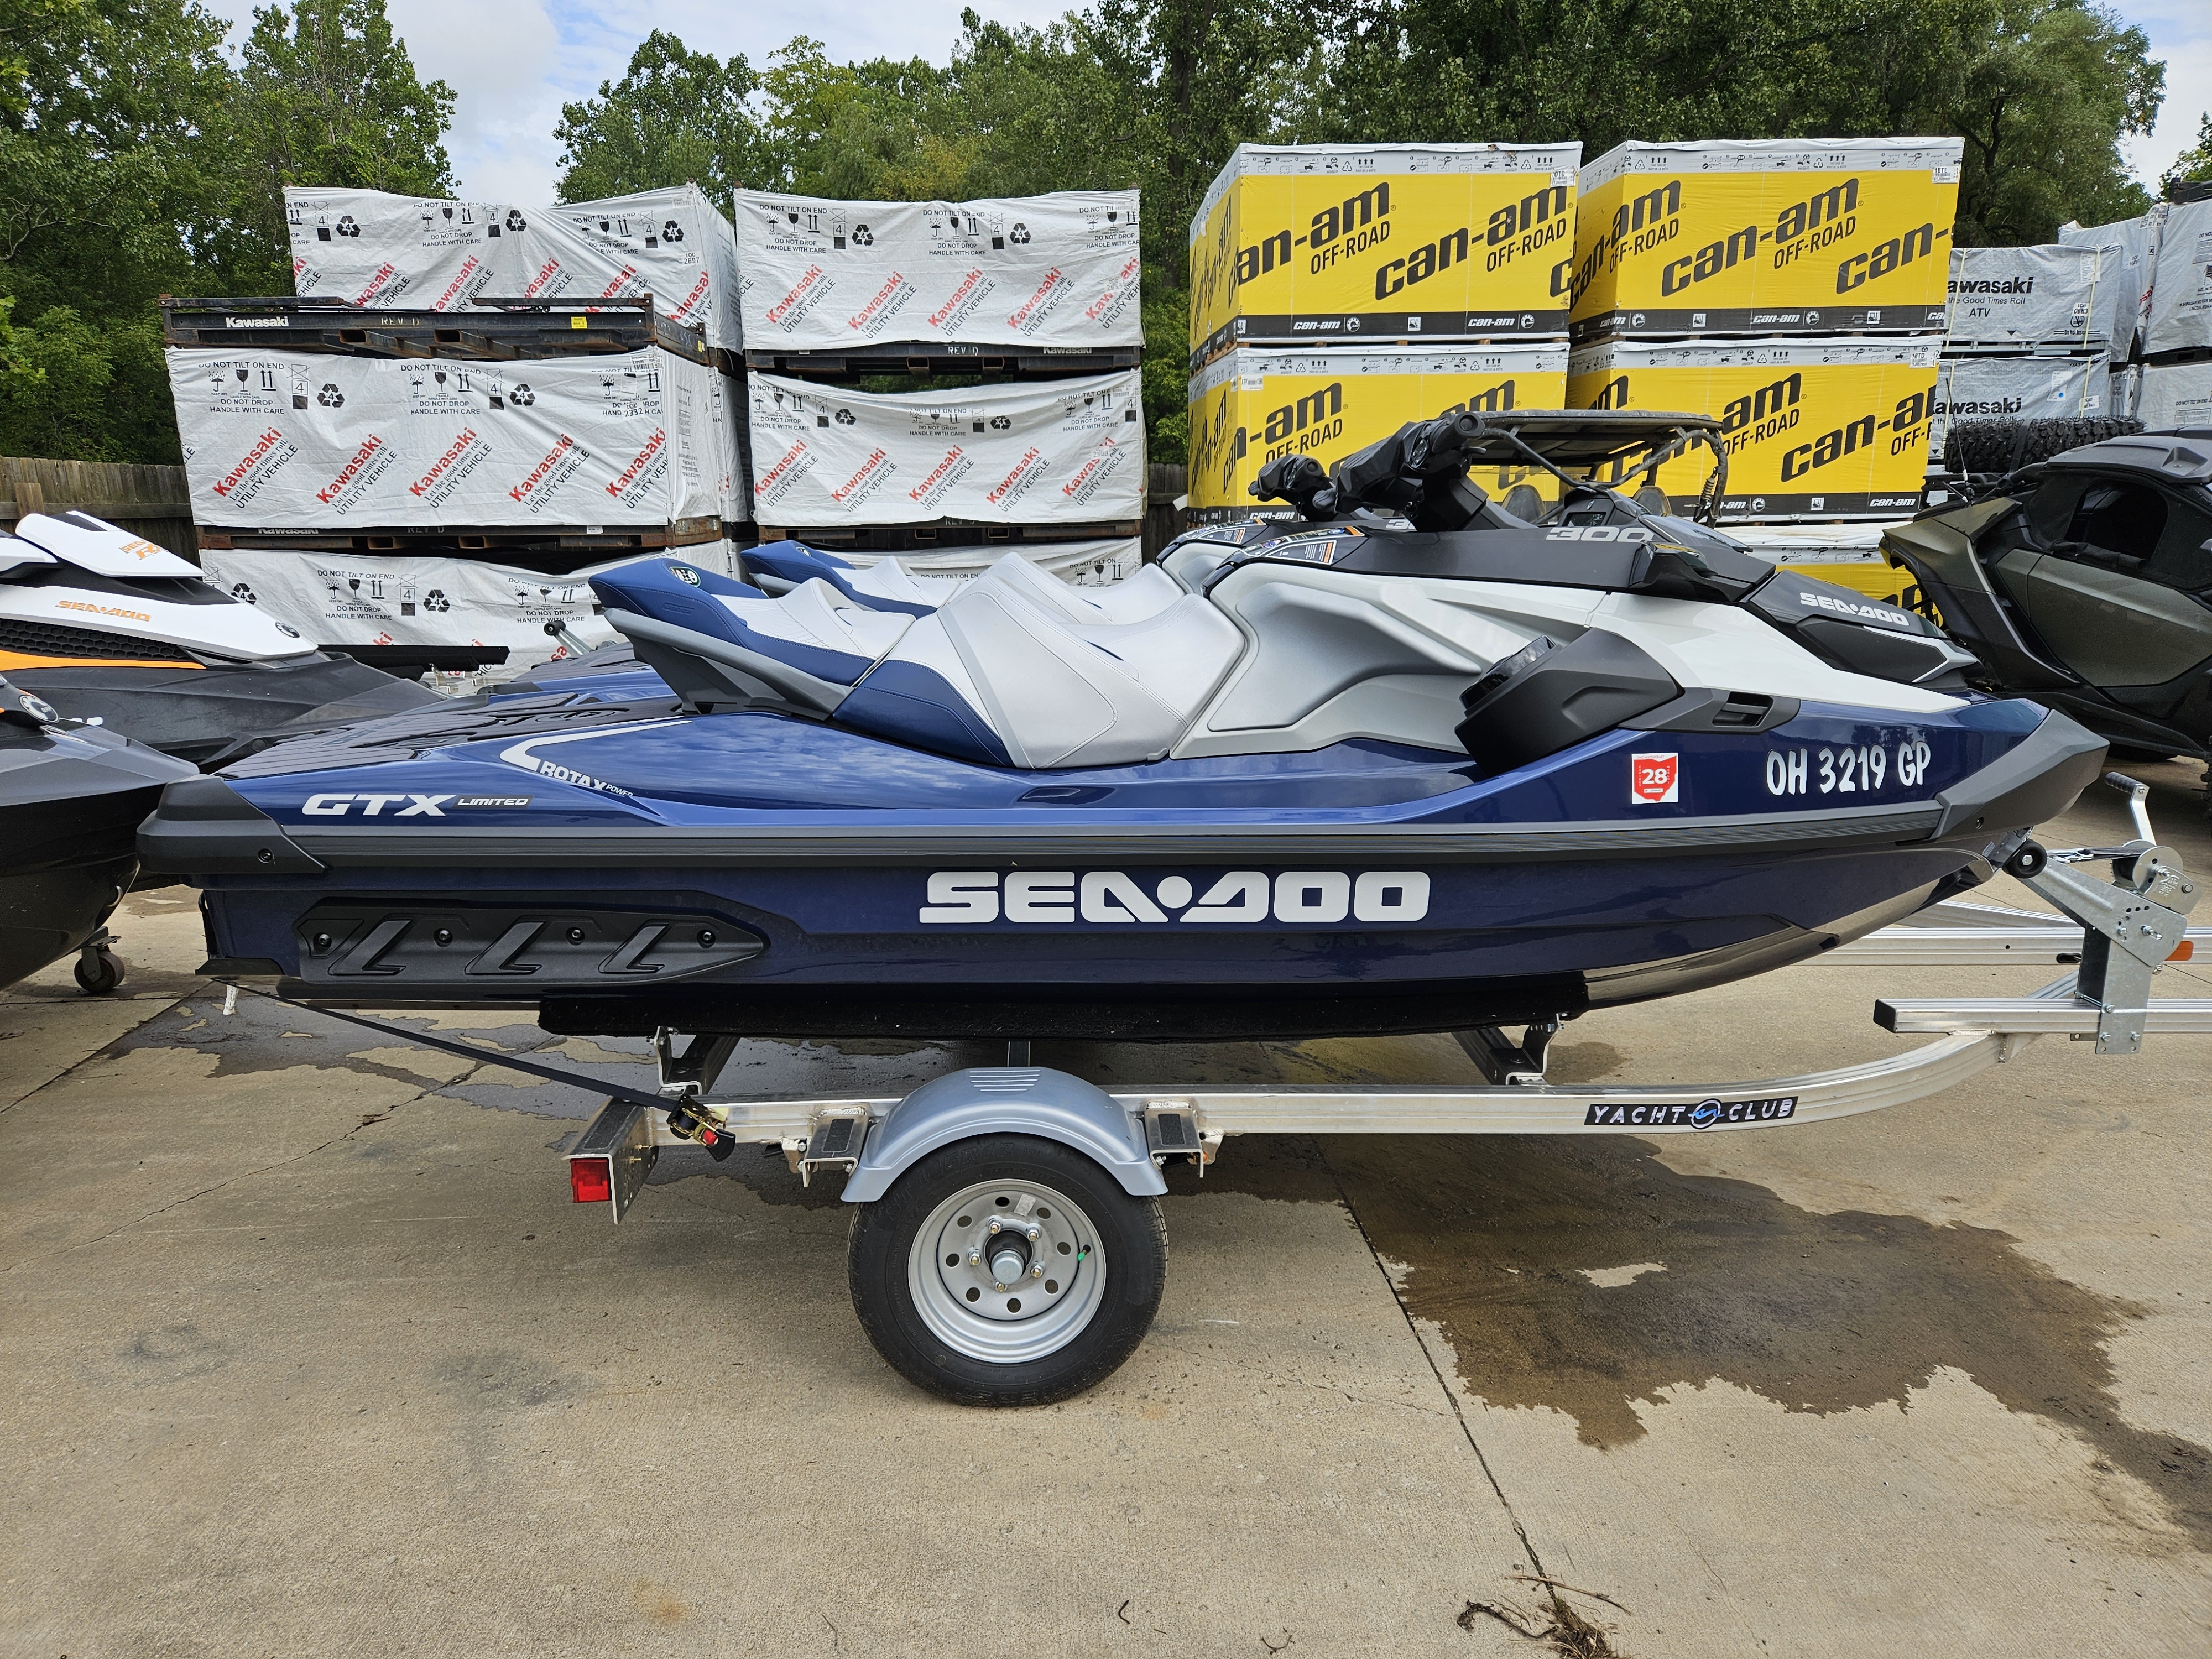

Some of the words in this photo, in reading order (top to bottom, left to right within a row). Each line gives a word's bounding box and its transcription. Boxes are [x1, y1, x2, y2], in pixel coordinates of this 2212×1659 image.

[1311, 220, 1390, 275] OFF-ROAD
[1375, 185, 1567, 301] can-am
[1486, 218, 1566, 272] OFF-ROAD
[1610, 218, 1679, 273] OFF-ROAD
[1662, 178, 1859, 297] can-am
[1773, 216, 1856, 270] OFF-ROAD
[226, 315, 289, 328] Kawasaki
[765, 264, 823, 324] Kawasaki
[784, 307, 808, 333] UTILITY
[807, 279, 836, 309] VEHICLE
[848, 271, 904, 330] Kawasaki
[866, 313, 890, 340] UTILITY
[888, 285, 917, 316] VEHICLE
[927, 267, 983, 328] Kawasaki
[946, 312, 969, 336] UTILITY
[969, 280, 995, 311] VEHICLE
[1007, 267, 1062, 329] Kawasaki
[1024, 311, 1048, 337] UTILITY
[1048, 280, 1075, 310] VEHICLE
[1468, 316, 1515, 327] can-am
[1600, 316, 1626, 327] can-am
[1753, 312, 1799, 323] can-am
[1969, 308, 1990, 317] ATV
[948, 346, 967, 354] REV
[1293, 320, 1340, 330] can-am
[624, 408, 644, 417] 2332
[1723, 408, 1799, 457] OFF-ROAD
[212, 426, 283, 497] Kawasaki
[231, 489, 241, 501] Let
[241, 481, 250, 492] the
[248, 466, 262, 484] good
[261, 451, 276, 470] times
[275, 440, 289, 452] roll.
[237, 478, 265, 509] UTILITY
[263, 445, 298, 483] VEHICLE
[316, 434, 383, 504] Kawasaki
[332, 497, 343, 508] Let
[343, 487, 352, 498] the
[352, 472, 366, 490] good
[362, 458, 378, 476] times
[377, 446, 389, 460] roll.
[337, 484, 367, 515] UTILITY
[364, 451, 397, 489] VEHICLE
[409, 427, 477, 497] Kawasaki
[430, 479, 460, 509] UTILITY
[458, 444, 492, 479] VEHICLE
[509, 434, 573, 502] Kawasaki
[530, 482, 559, 514] UTILITY
[556, 450, 589, 484] VEHICLE
[754, 439, 807, 496] Kawasaki
[767, 482, 791, 507] UTILITY
[792, 456, 818, 483] VEHICLE
[831, 448, 886, 503] Kawasaki
[847, 489, 870, 512] UTILITY
[871, 463, 897, 491] VEHICLE
[909, 445, 963, 501] Kawasaki
[925, 489, 948, 511] UTILITY
[946, 459, 974, 487] VEHICLE
[987, 447, 1040, 504] Kawasaki
[1001, 488, 1025, 512] UTILITY
[1025, 459, 1050, 489] VEHICLE
[626, 477, 655, 509] UTILITY
[1250, 511, 1295, 520] can-am
[1869, 498, 1916, 508] can-am
[1546, 526, 1654, 542] 300
[540, 760, 607, 791] ROTAX
[606, 783, 633, 796] POWER
[1641, 768, 1668, 784] 28
[1767, 747, 1808, 797] OH
[1819, 743, 1887, 794] 3219
[1897, 740, 1932, 787] GP
[302, 794, 457, 816] GTX
[457, 797, 529, 808] LIMITED
[1594, 1106, 1686, 1124] YACHT
[1729, 1099, 1794, 1121] CLUB
